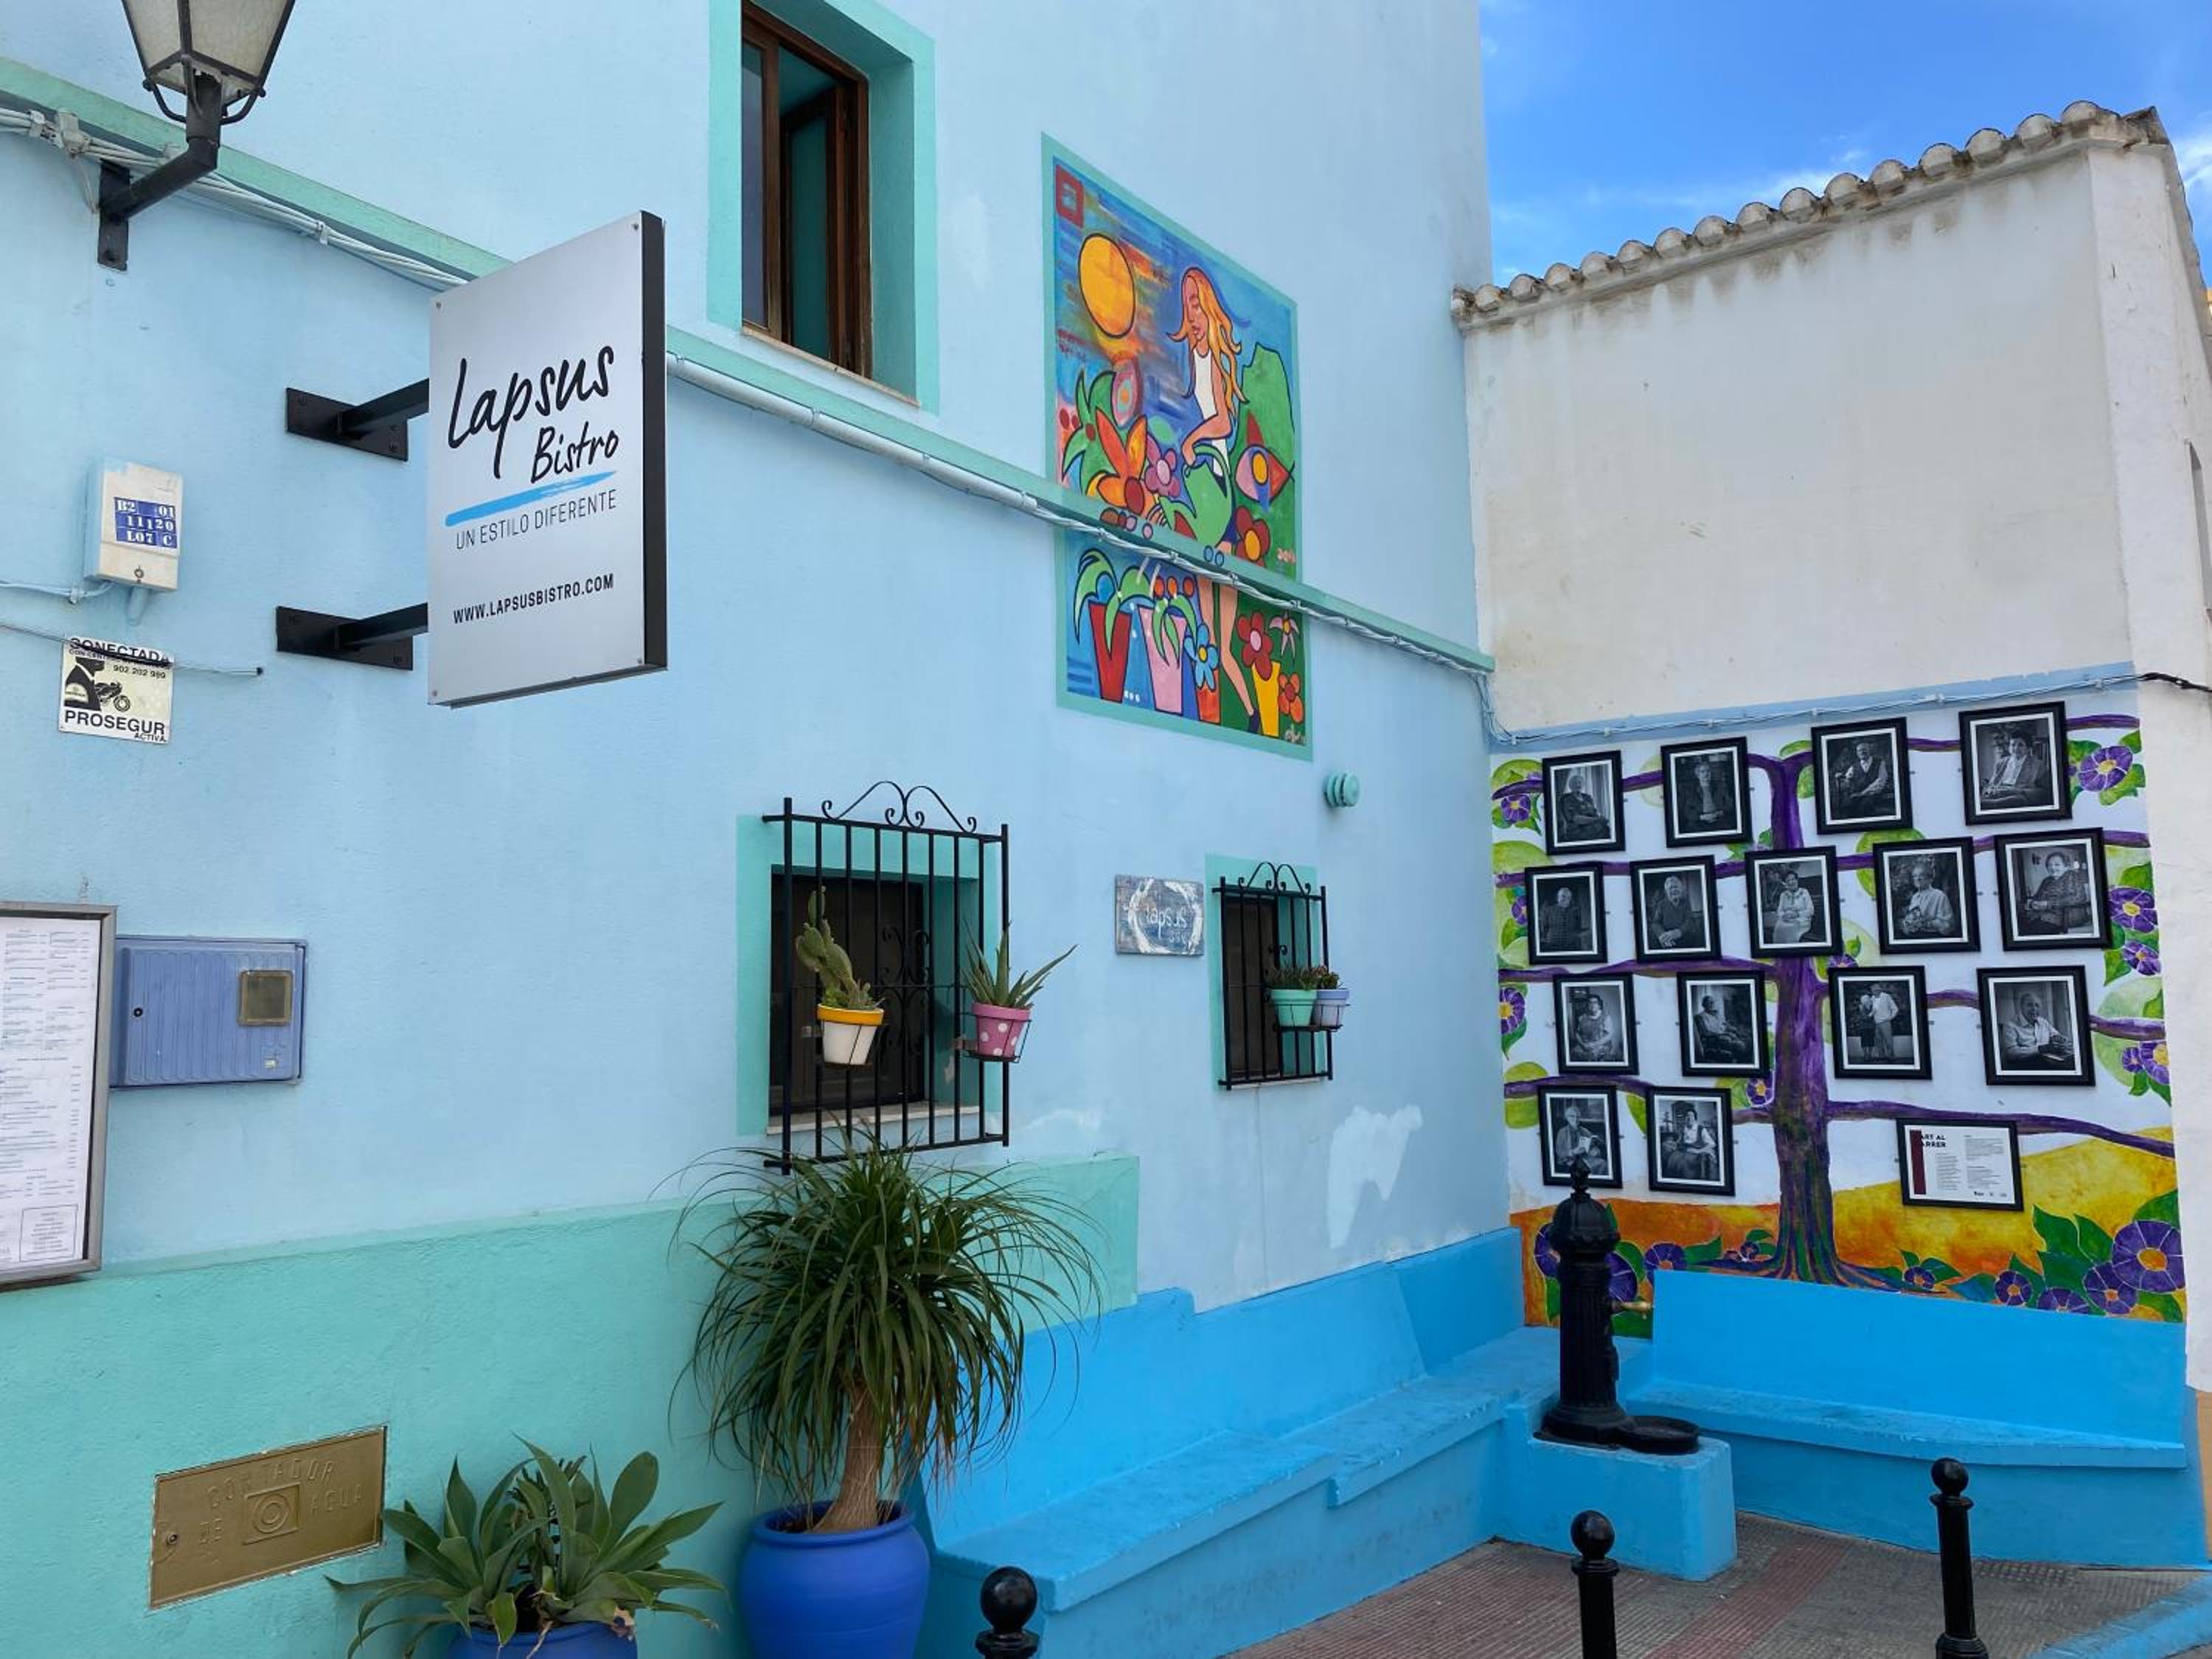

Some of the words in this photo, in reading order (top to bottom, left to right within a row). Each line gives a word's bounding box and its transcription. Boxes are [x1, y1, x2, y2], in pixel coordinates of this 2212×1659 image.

[448, 346, 614, 479] Lapsus
[530, 421, 619, 484] Bistro
[456, 529, 475, 550] UN
[480, 514, 529, 544] ESTILO
[535, 489, 617, 529] DIFERENTE
[453, 573, 614, 625] WWW.LAPSUSBISTRO.COM
[65, 710, 164, 735] PROSEGUR
[134, 732, 167, 742] ACTIVA
